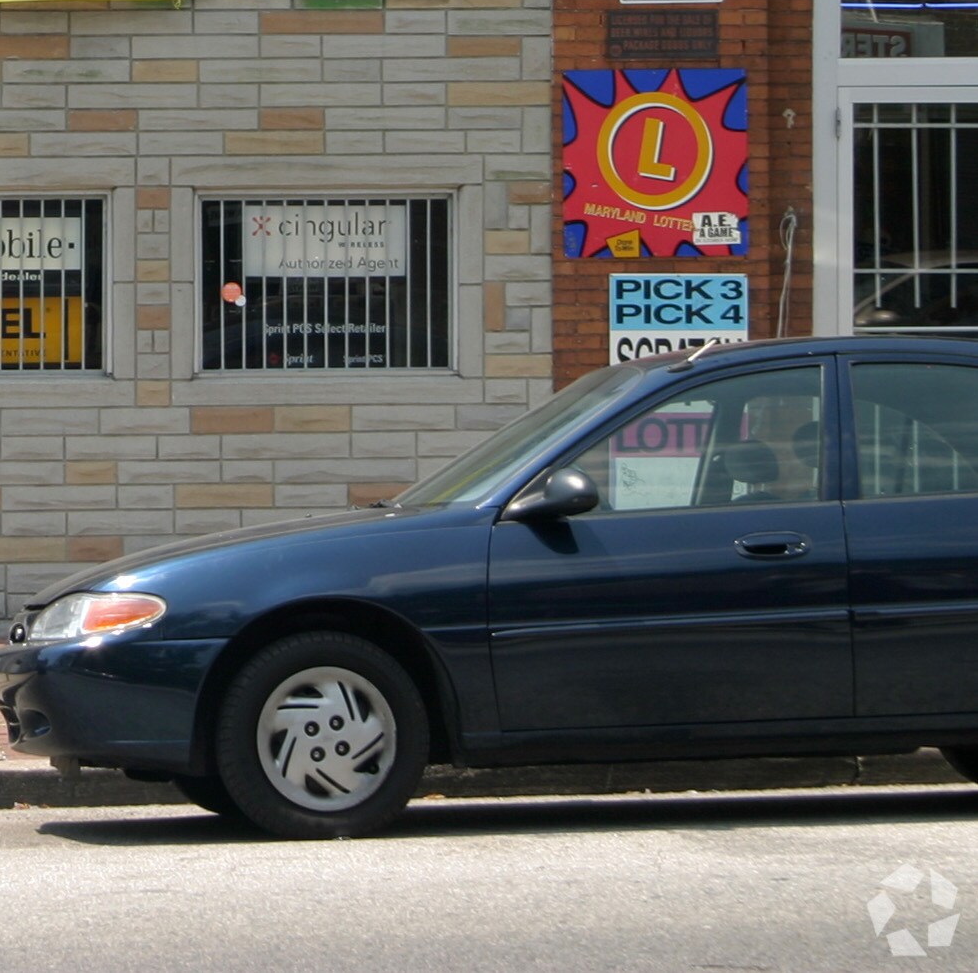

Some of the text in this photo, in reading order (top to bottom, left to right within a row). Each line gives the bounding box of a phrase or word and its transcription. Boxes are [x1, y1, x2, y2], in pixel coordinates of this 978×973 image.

[638, 117, 675, 182] L
[584, 203, 647, 224] MARYLAND
[278, 212, 387, 243] cingular
[708, 228, 733, 237] GAME
[278, 256, 399, 272] Authorzed Agent
[615, 279, 744, 300] PICK 3
[615, 304, 744, 324] PICK 4
[293, 323, 312, 333] PCS
[616, 415, 714, 453] LOTT
